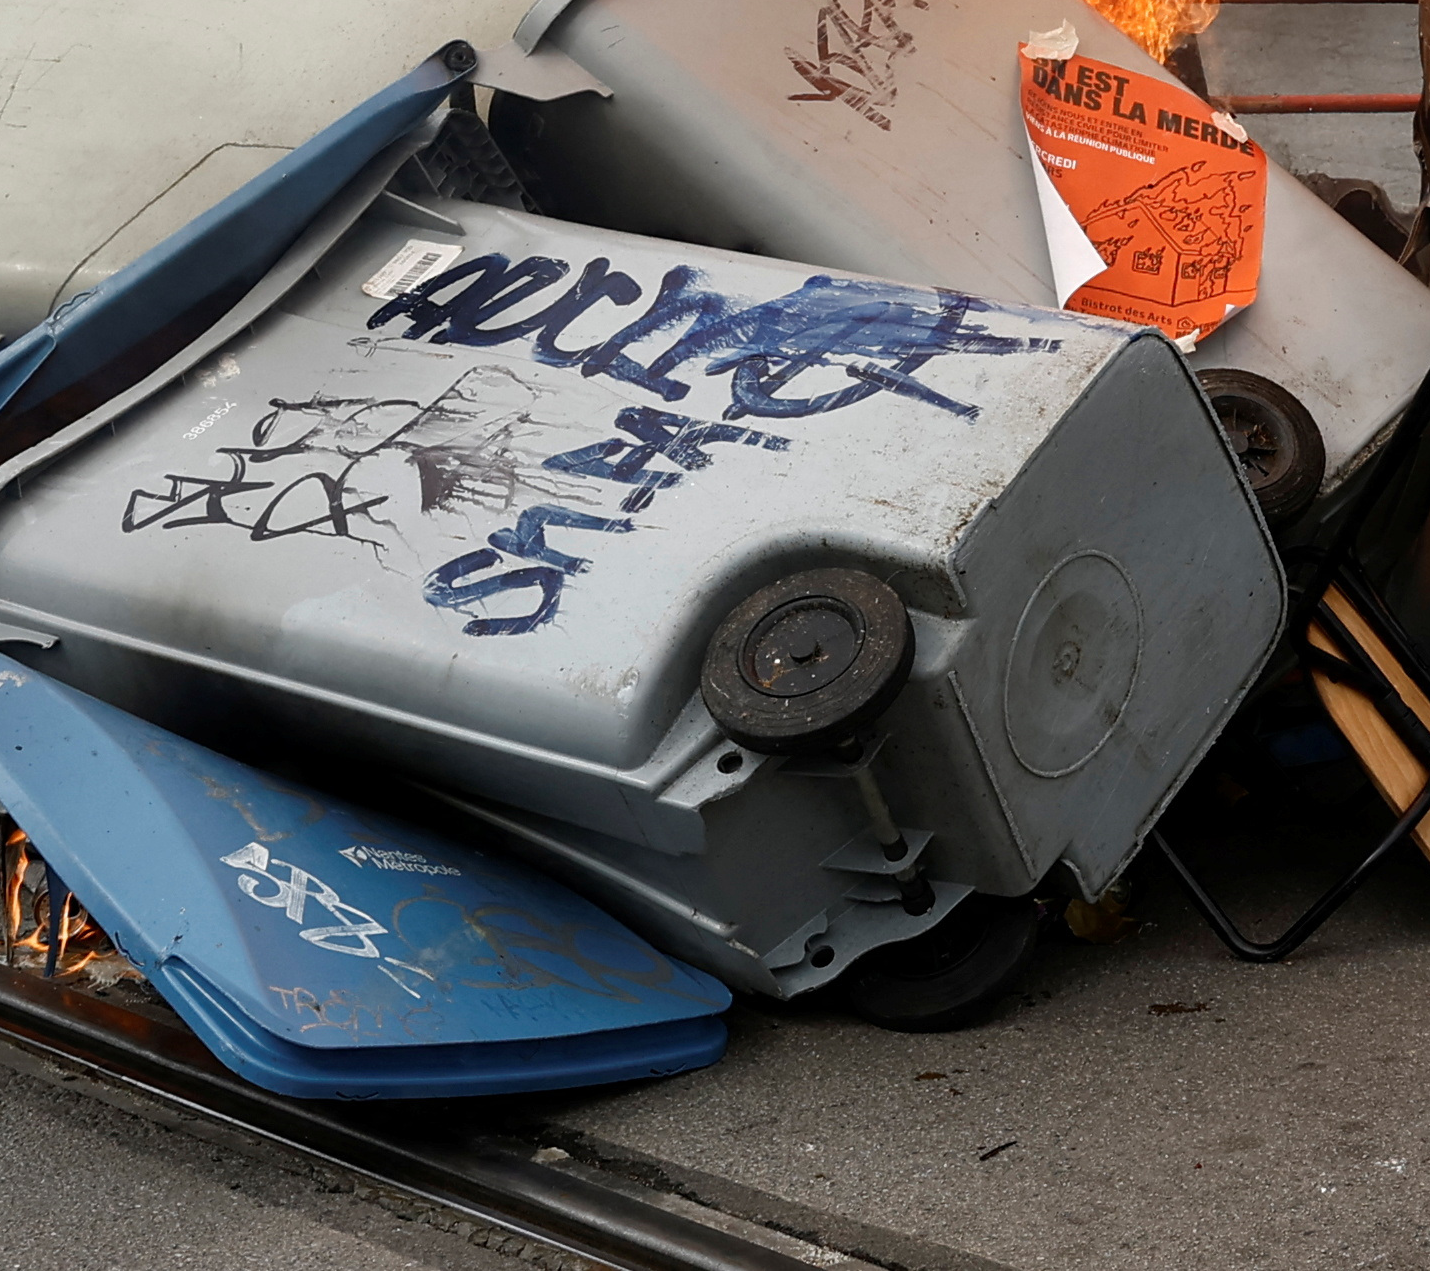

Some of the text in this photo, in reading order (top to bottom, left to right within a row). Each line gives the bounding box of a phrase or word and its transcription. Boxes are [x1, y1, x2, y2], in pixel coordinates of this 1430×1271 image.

[1033, 64, 1102, 111] DANS
[1112, 96, 1147, 125] LA
[1077, 64, 1130, 98] EST
[1059, 109, 1086, 122] NOUS
[1087, 115, 1098, 124] ET
[1100, 119, 1129, 134] ENTRE
[1131, 127, 1144, 138] EN
[1077, 120, 1105, 134] CIVILE
[1106, 127, 1131, 142] POUR
[1133, 134, 1169, 153] LIMITER
[1053, 130, 1066, 140] LA
[1110, 146, 1156, 165] PUBLIQUE
[1101, 134, 1157, 157] CLIMATIQUE
[1081, 297, 1123, 315] Bistrot
[1124, 307, 1146, 319] des
[1146, 312, 1173, 326] Arts
[361, 845, 427, 864] Nantes
